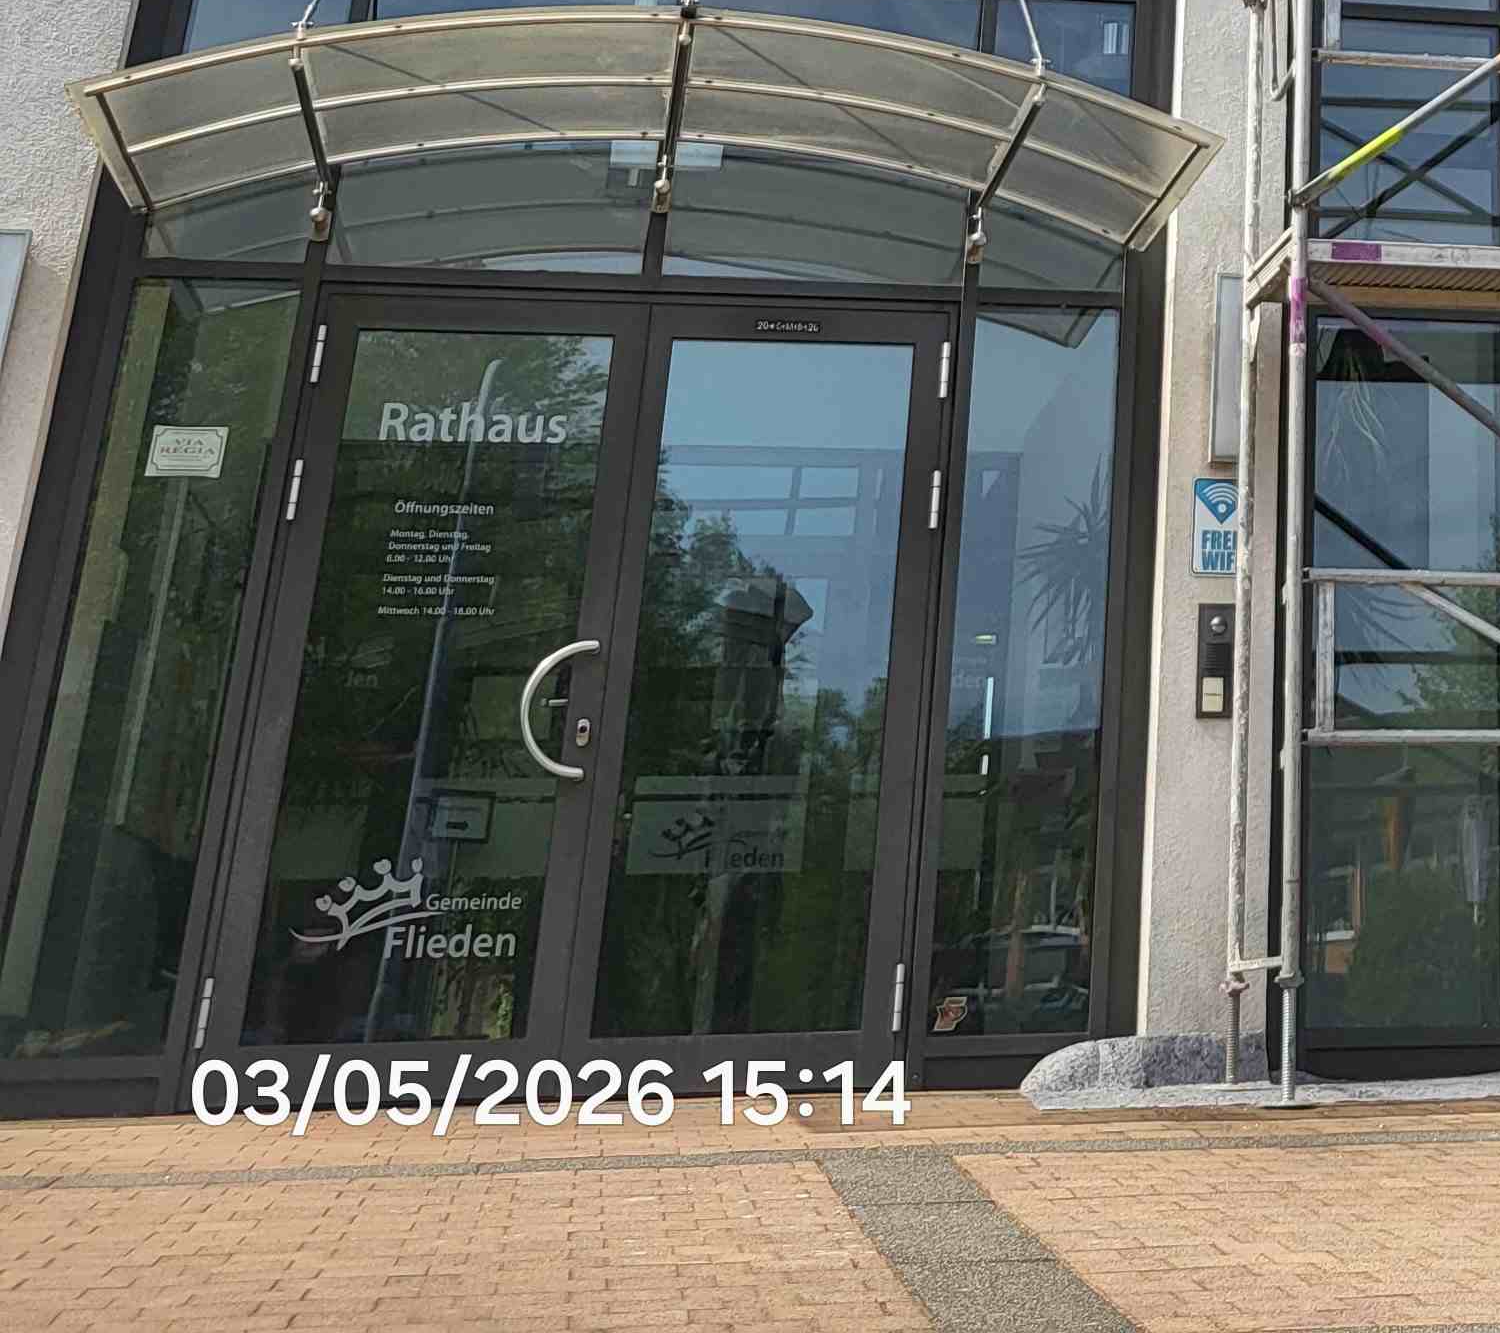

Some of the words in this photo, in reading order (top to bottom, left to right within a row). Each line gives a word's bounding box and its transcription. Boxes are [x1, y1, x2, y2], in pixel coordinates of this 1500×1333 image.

[378, 402, 568, 444] Rathaus
[394, 499, 495, 517] Öffnungszeiten
[1201, 549, 1236, 571] WIF
[425, 892, 523, 911] Gemeinde
[384, 923, 517, 959] Flieden
